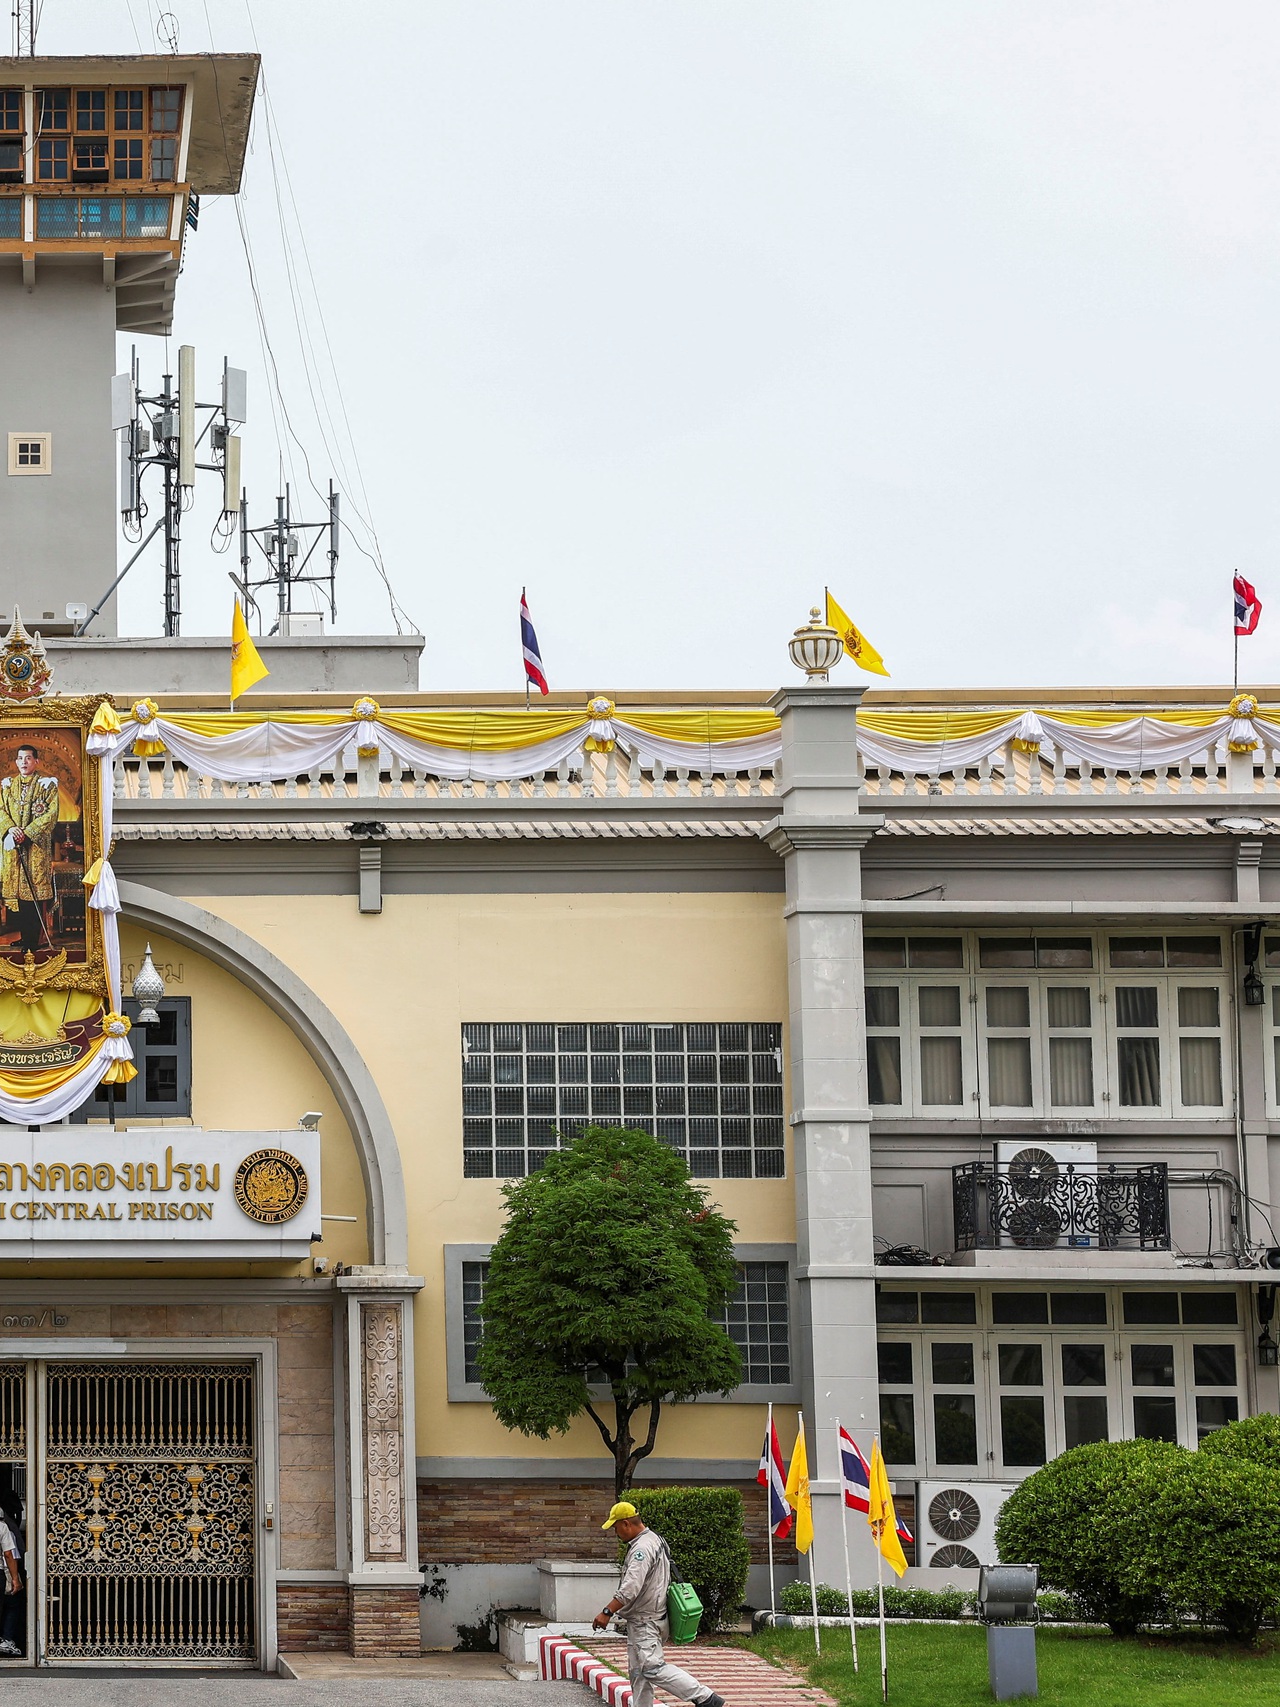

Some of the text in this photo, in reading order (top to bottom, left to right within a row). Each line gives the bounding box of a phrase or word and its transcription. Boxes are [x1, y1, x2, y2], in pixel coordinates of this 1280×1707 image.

[234, 1173, 308, 1222] DEPARTMENT OF CORRECTIONS
[10, 1202, 123, 1221] CENTRAL
[128, 1202, 214, 1221] PRISON
[2, 1310, 68, 1327] ๓๓/๒
